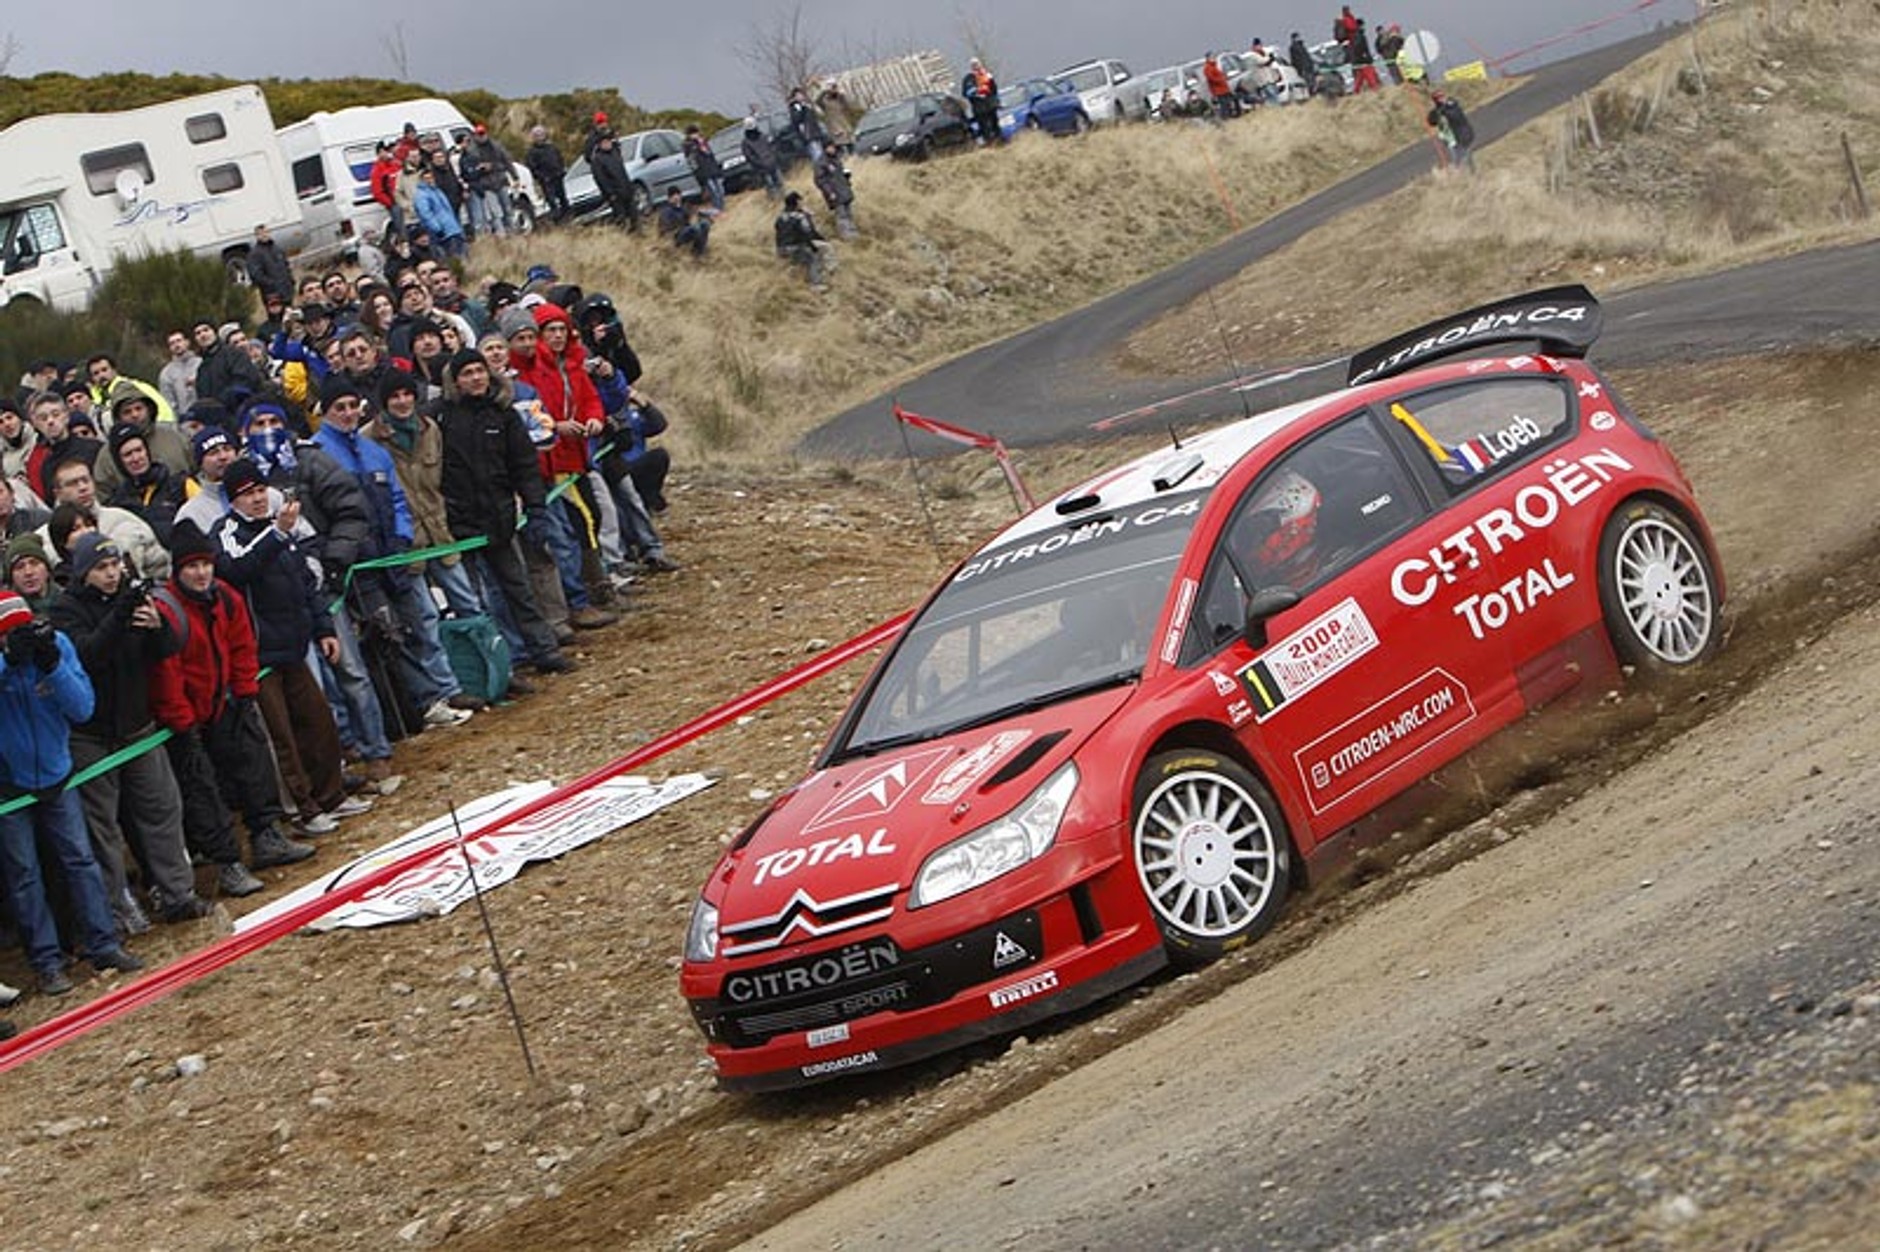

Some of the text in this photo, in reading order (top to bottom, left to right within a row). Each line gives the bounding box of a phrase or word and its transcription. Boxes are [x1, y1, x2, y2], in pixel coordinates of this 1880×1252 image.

[1527, 307, 1586, 322] C4
[1478, 415, 1541, 460] Loeb
[953, 499, 1200, 582] CITROËN C4
[1391, 448, 1634, 606] CITROËN
[1453, 558, 1575, 639] TOTAL
[1288, 619, 1342, 659] 2008
[1246, 668, 1275, 711] 1
[1330, 686, 1454, 776] CITROEN-WRC.COM
[753, 828, 896, 886] TOTAL
[727, 942, 899, 1002] CITROËN
[988, 971, 1059, 1008] PIRELLI
[841, 981, 911, 1015] SPORT
[802, 1051, 878, 1077] EURODATACAR
